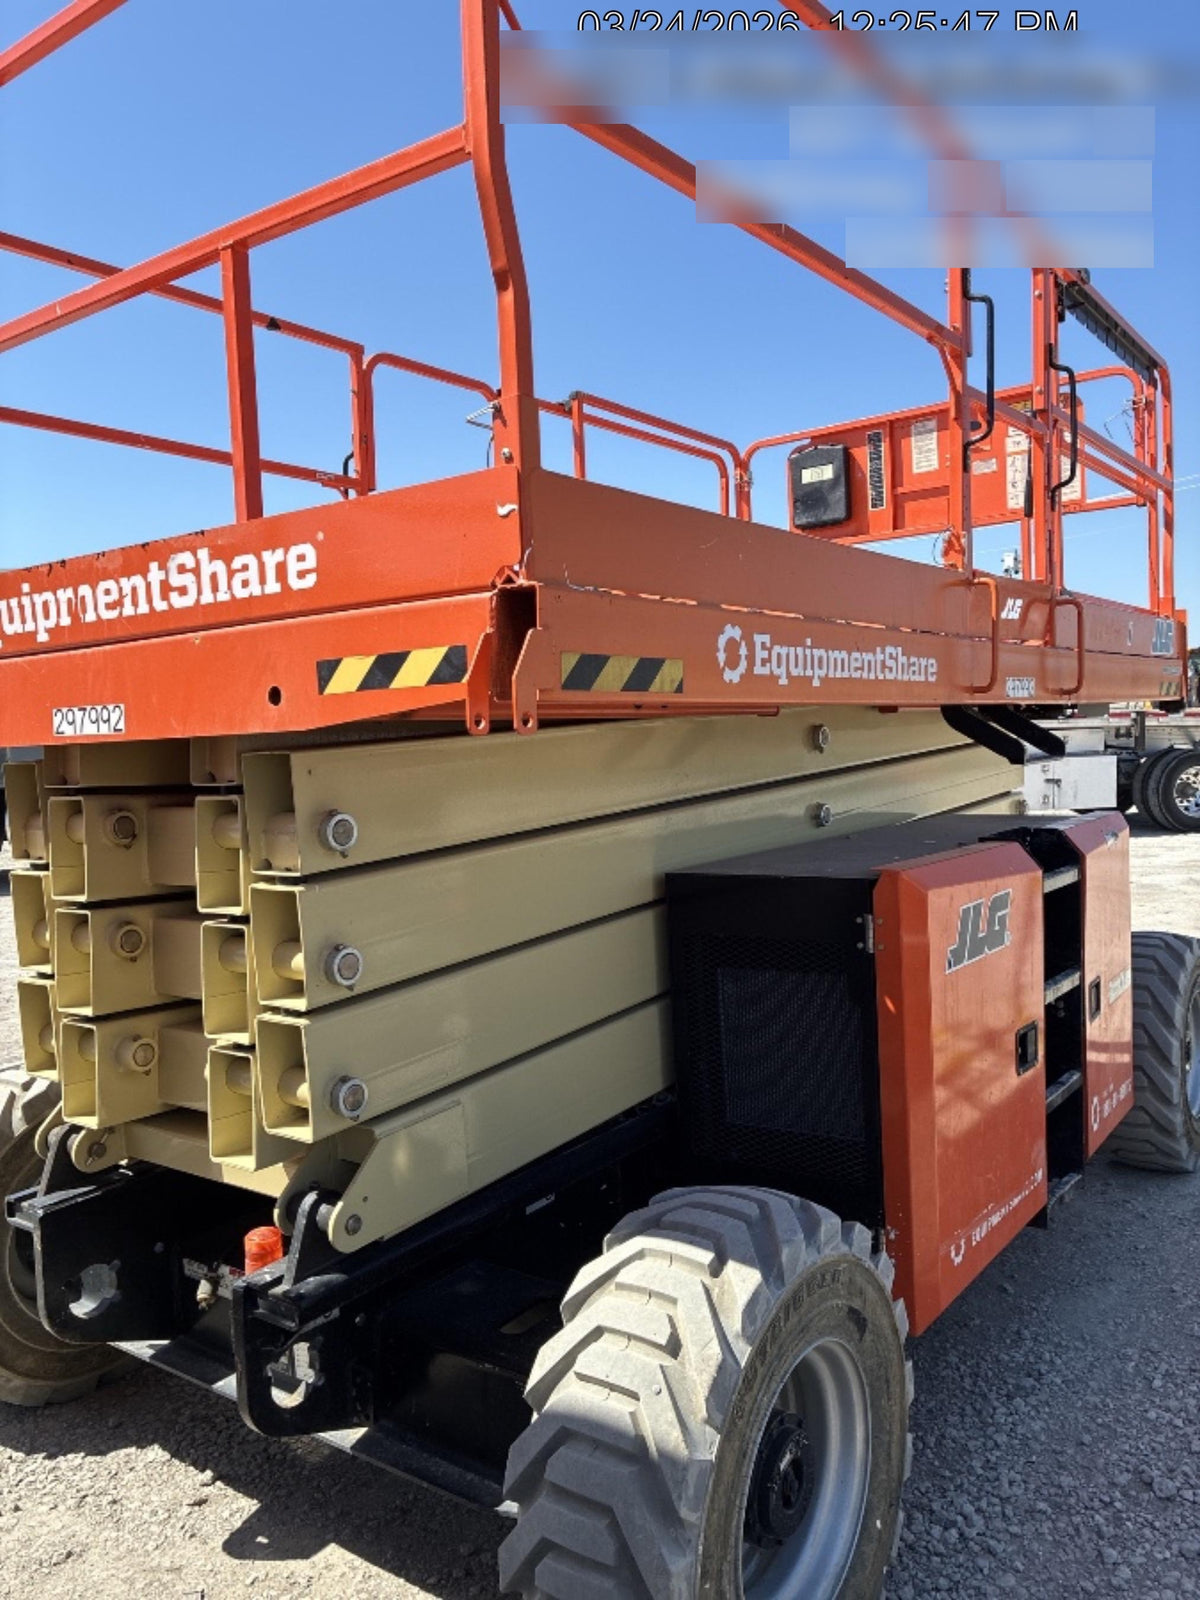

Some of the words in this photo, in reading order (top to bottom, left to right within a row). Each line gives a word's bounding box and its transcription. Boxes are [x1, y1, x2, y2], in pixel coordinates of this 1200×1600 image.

[752, 633, 938, 687] EquipmentShare
[53, 704, 124, 735] 297992
[945, 887, 1013, 975] JLG
